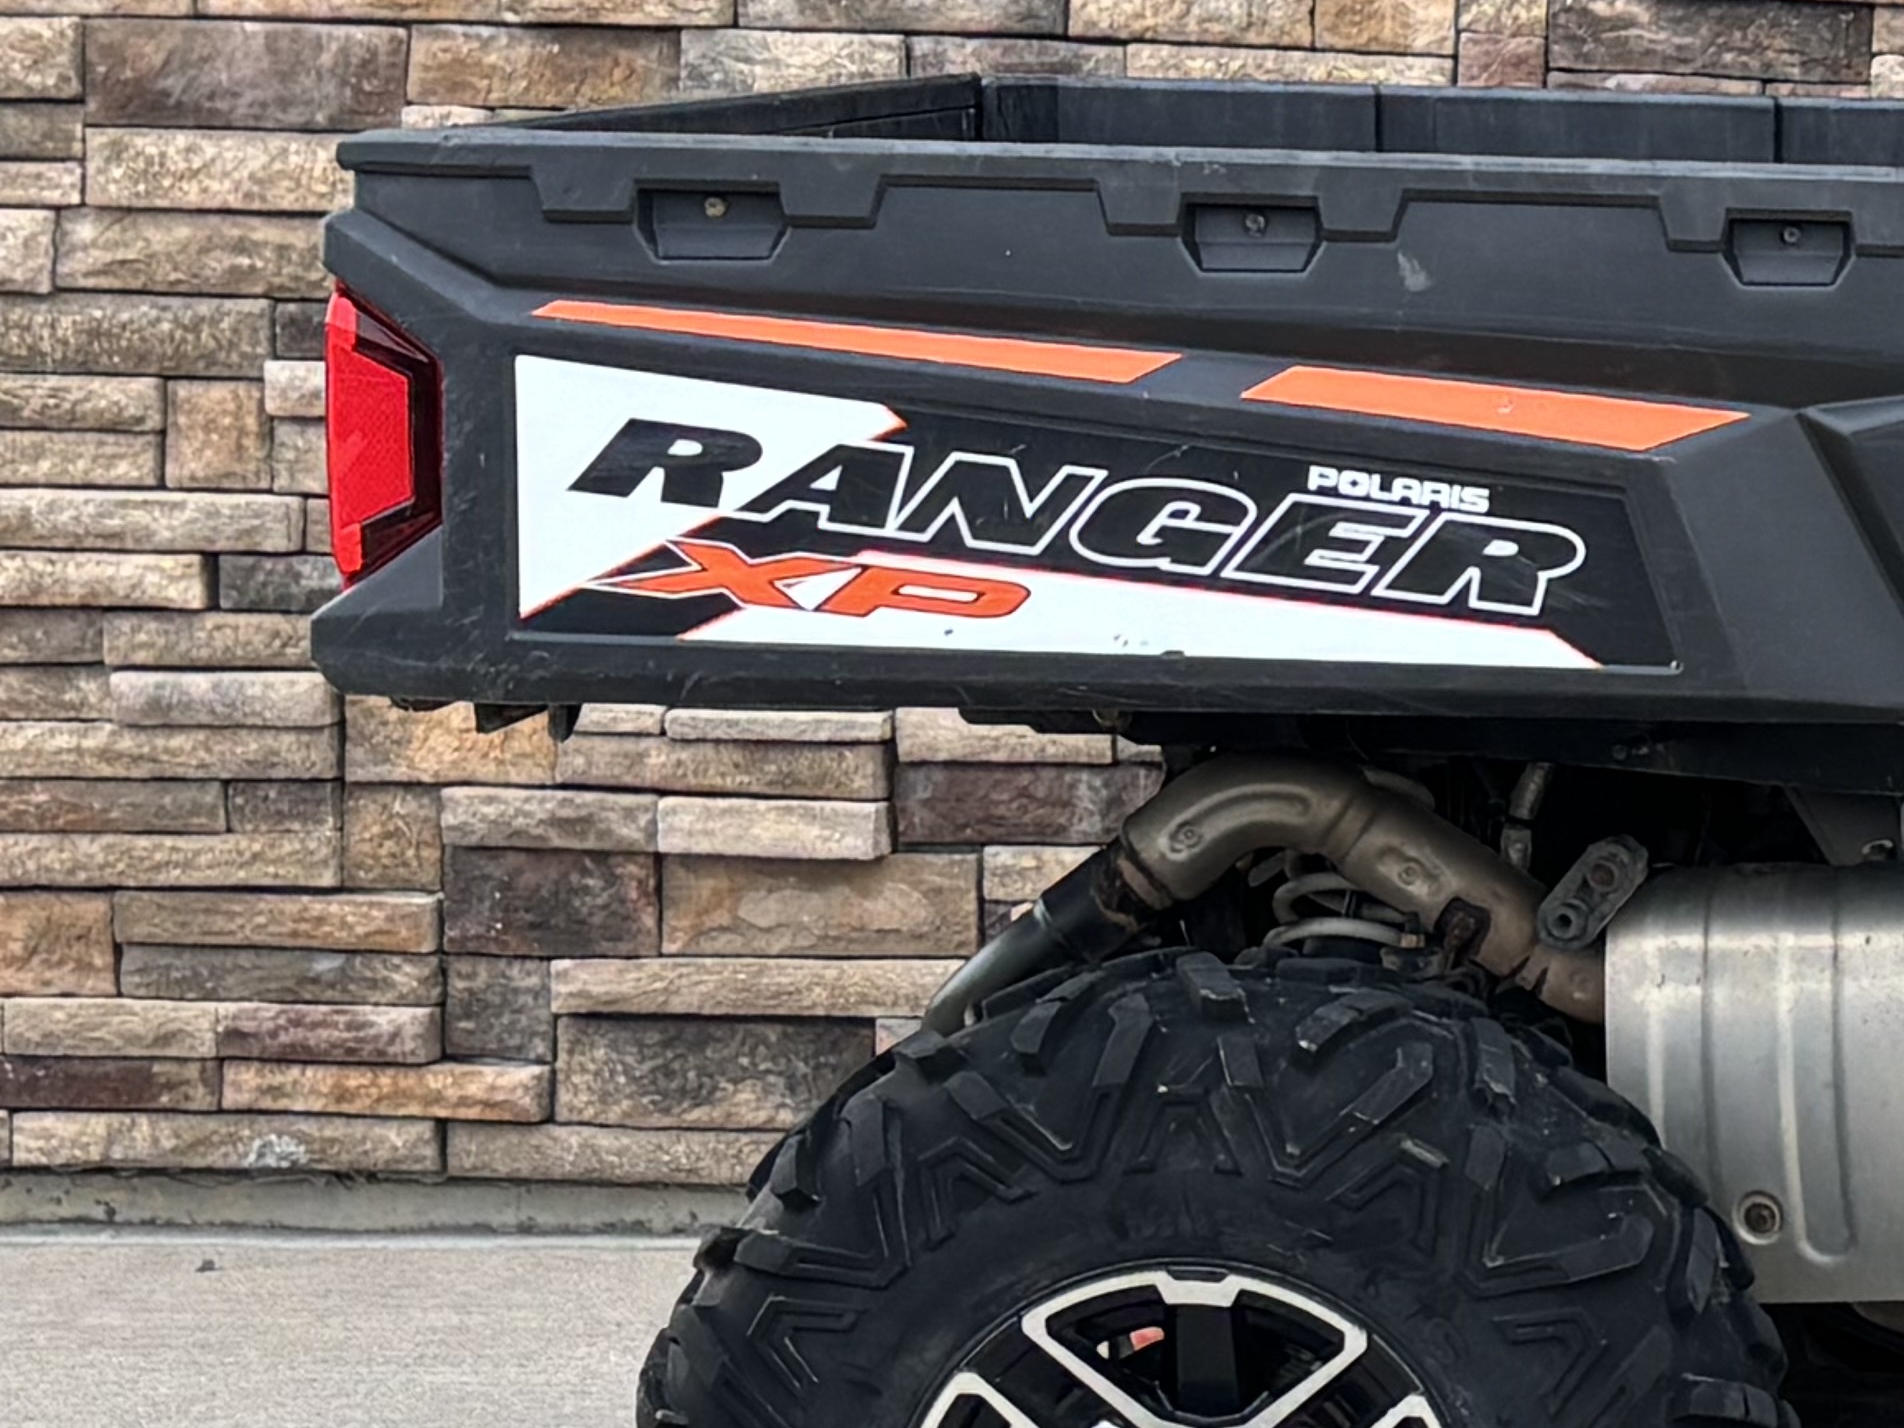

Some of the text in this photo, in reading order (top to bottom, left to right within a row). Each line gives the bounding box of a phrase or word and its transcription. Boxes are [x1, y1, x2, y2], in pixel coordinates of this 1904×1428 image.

[568, 417, 1587, 616] RANGER
[1307, 465, 1490, 514] POLARIS
[580, 538, 1032, 619] XP
